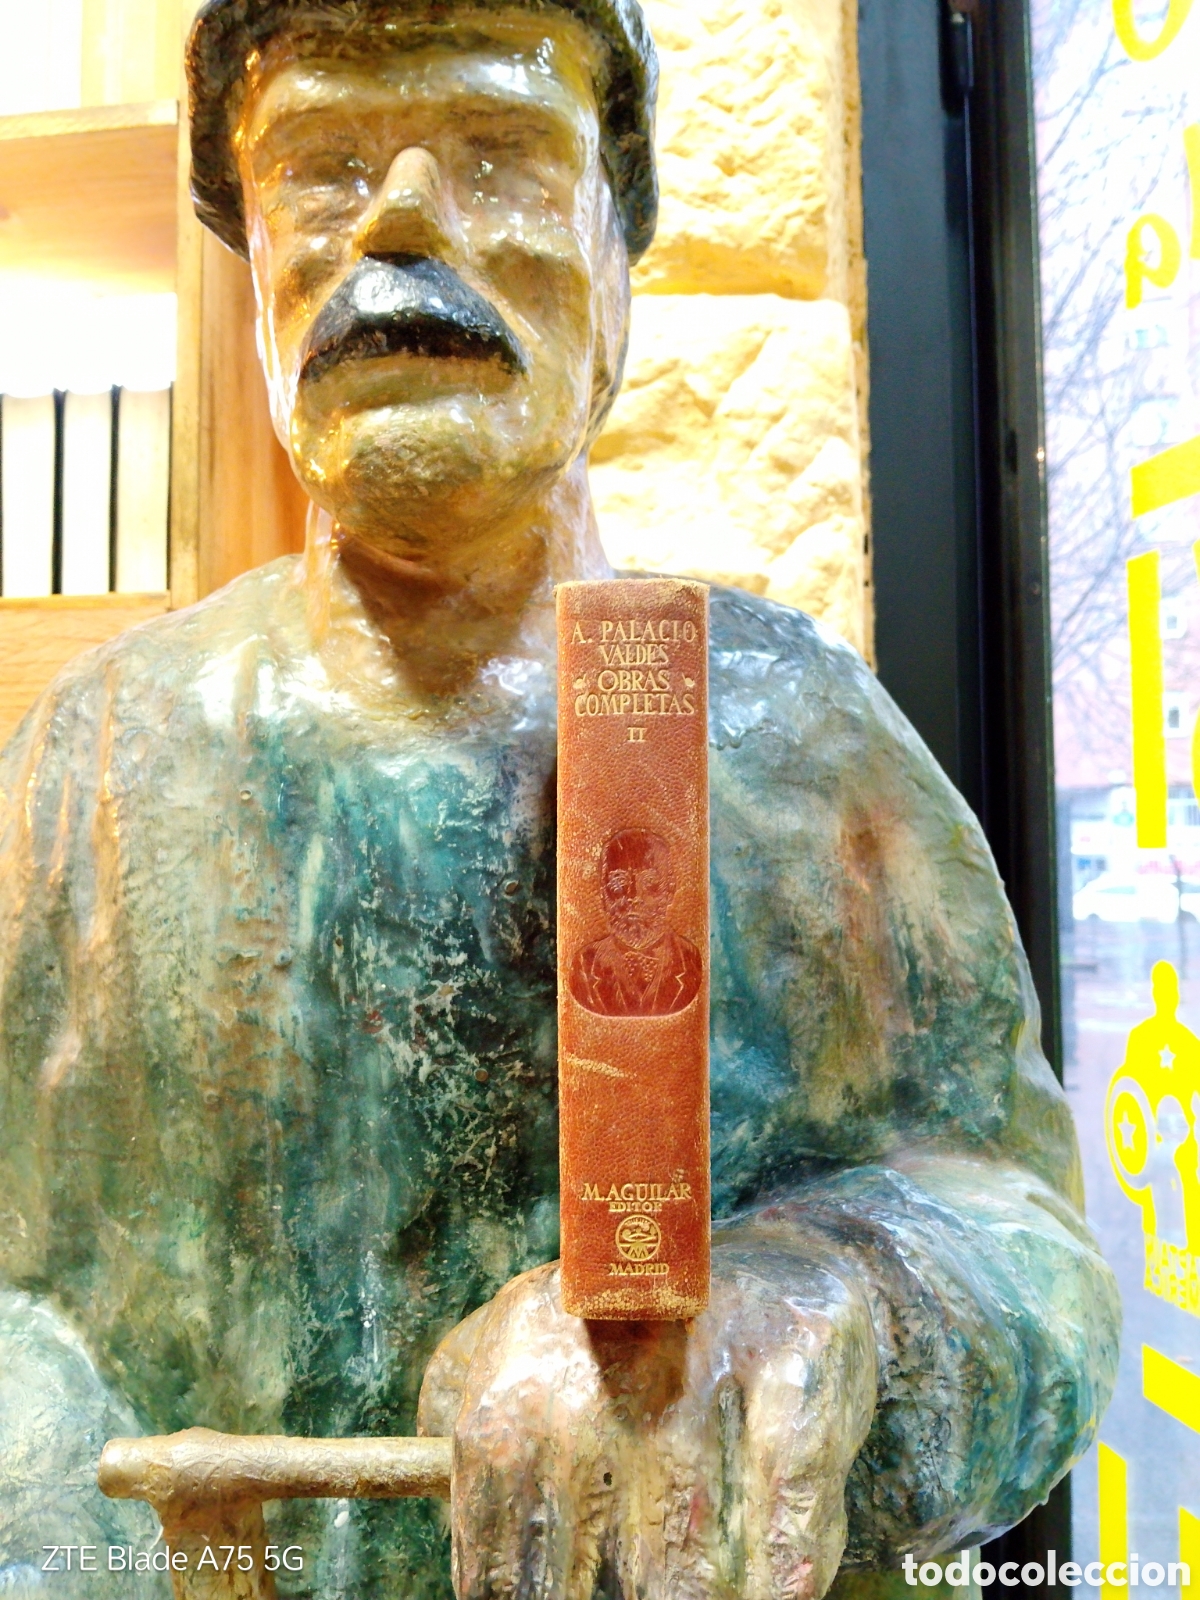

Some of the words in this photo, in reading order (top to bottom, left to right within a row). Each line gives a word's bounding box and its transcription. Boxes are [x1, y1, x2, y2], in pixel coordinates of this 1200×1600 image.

[571, 621, 593, 644] A.
[601, 620, 697, 643] PALACIO
[599, 643, 669, 666] VALDES
[597, 669, 670, 692] OBRAS
[574, 693, 695, 717] COMPLETAS
[627, 727, 647, 742] II
[608, 1201, 663, 1213] EDITOR
[609, 1263, 670, 1276] MADRID
